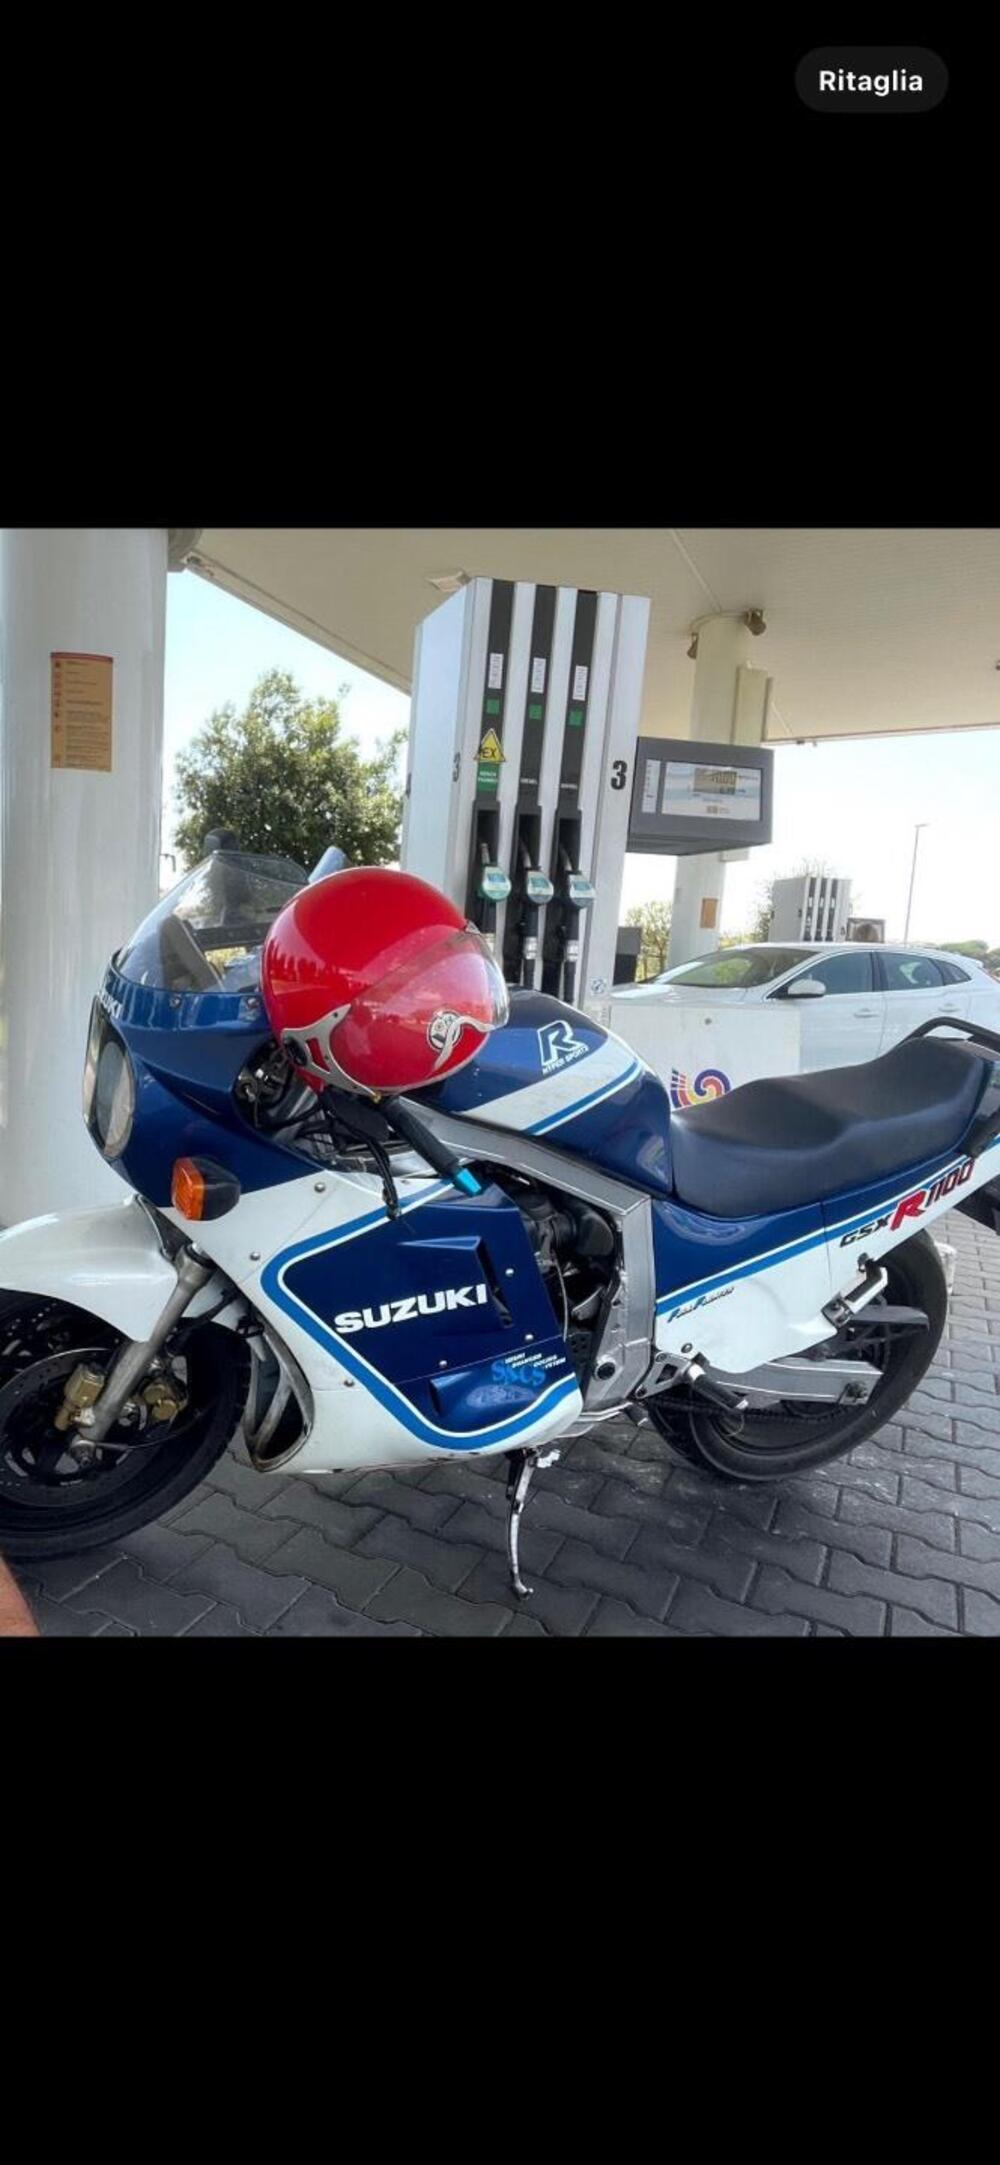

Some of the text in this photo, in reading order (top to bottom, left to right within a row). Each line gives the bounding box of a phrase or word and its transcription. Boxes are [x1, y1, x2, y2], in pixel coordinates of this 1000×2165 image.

[611, 760, 628, 790] 3
[537, 1020, 588, 1067] R
[333, 1284, 488, 1334] SUZUKI
